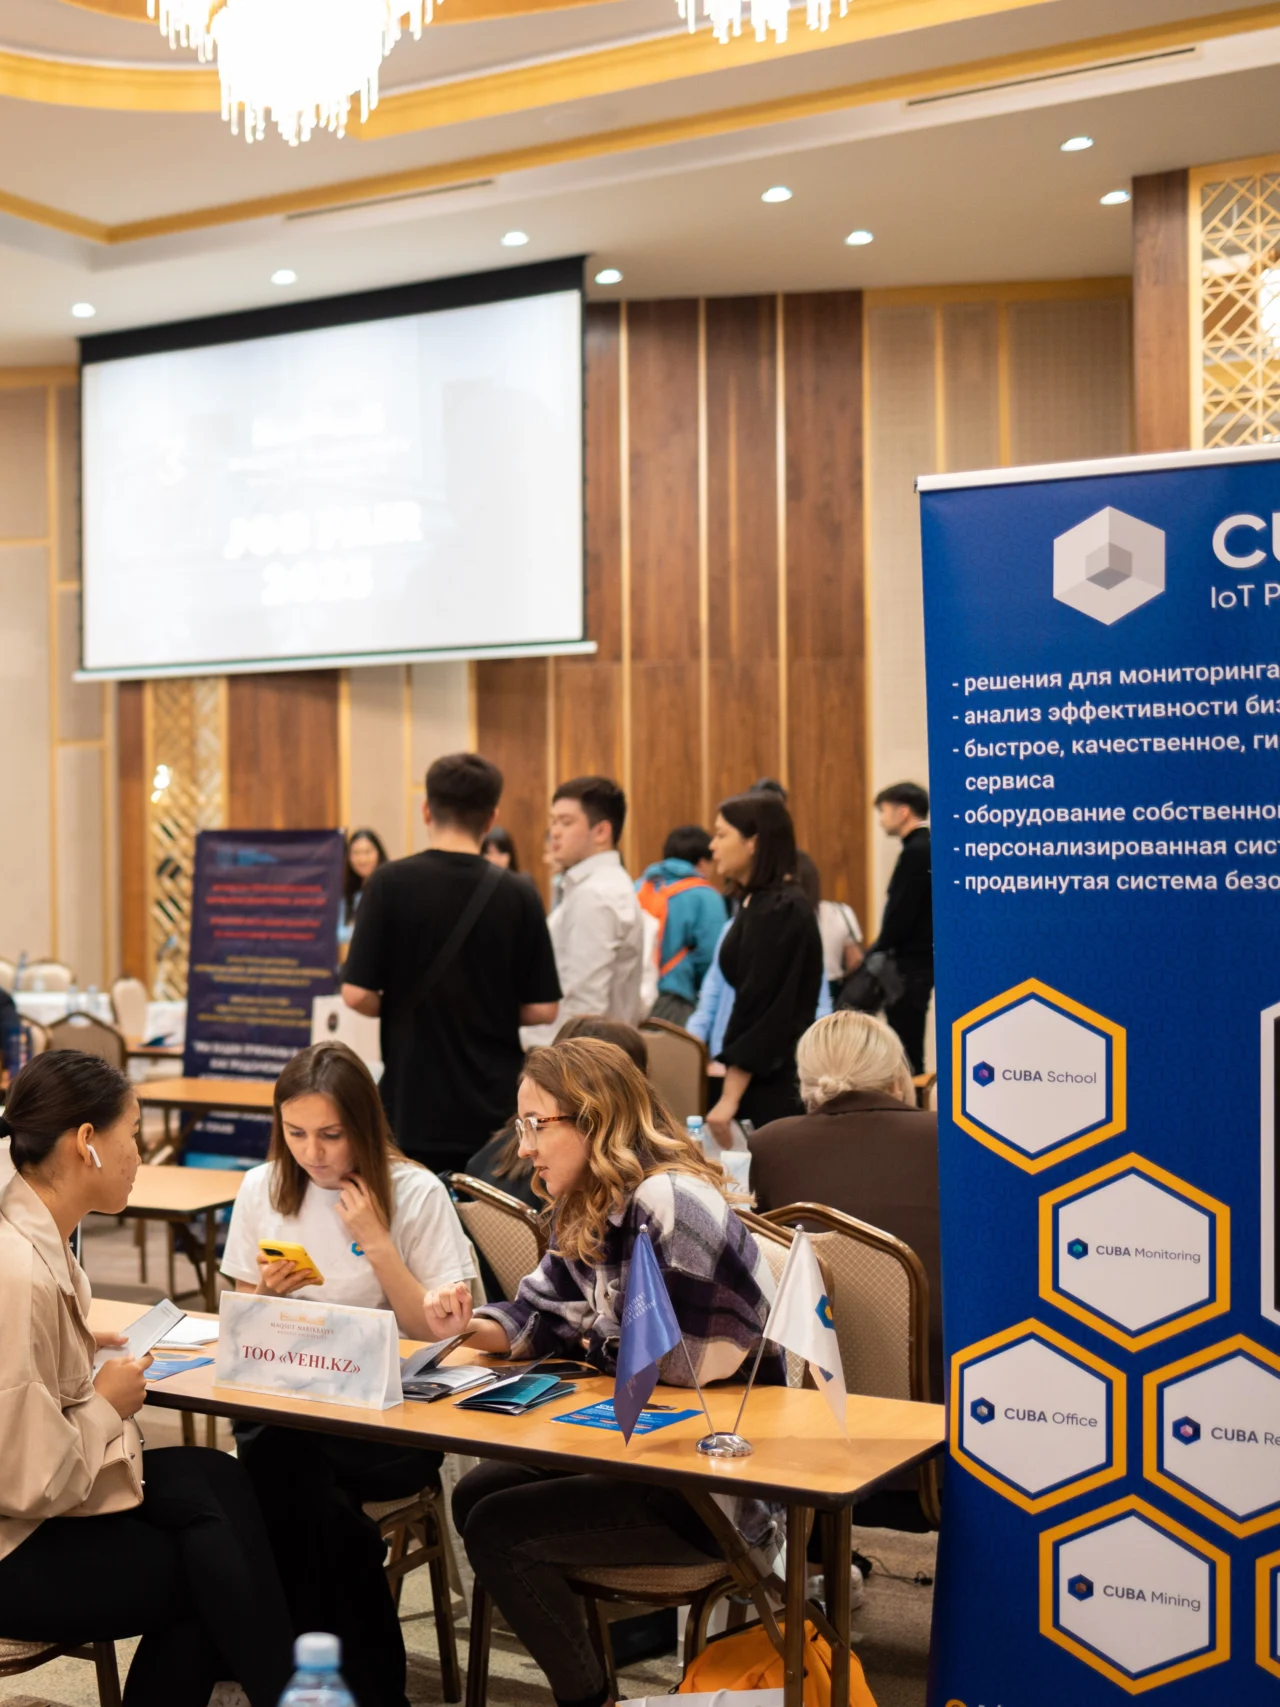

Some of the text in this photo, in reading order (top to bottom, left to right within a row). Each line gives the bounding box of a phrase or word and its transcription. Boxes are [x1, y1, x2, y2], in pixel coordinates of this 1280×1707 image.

[1211, 584, 1256, 609] IoT
[964, 672, 1062, 697] решения
[1068, 670, 1112, 691] для
[1119, 663, 1280, 686] мониторинга
[964, 707, 1042, 725] анализ
[1047, 700, 1238, 725] эффективности
[964, 738, 1065, 761] быстрое,
[1071, 734, 1246, 756] качественное,
[965, 774, 1055, 795] сервиса
[964, 803, 1126, 828] оборудование
[1132, 801, 1280, 822] собственно
[965, 839, 1227, 861] персонализированная
[1234, 838, 1280, 855] сис
[965, 874, 1109, 895] продвинутая
[1116, 874, 1218, 890] система
[1002, 1069, 1097, 1084] CUBA School
[1095, 1245, 1201, 1264] CUBA Monitoring
[1004, 1407, 1098, 1428] CUBA Office
[1210, 1426, 1259, 1444] CUBA
[1102, 1584, 1201, 1613] CUBA Mining
